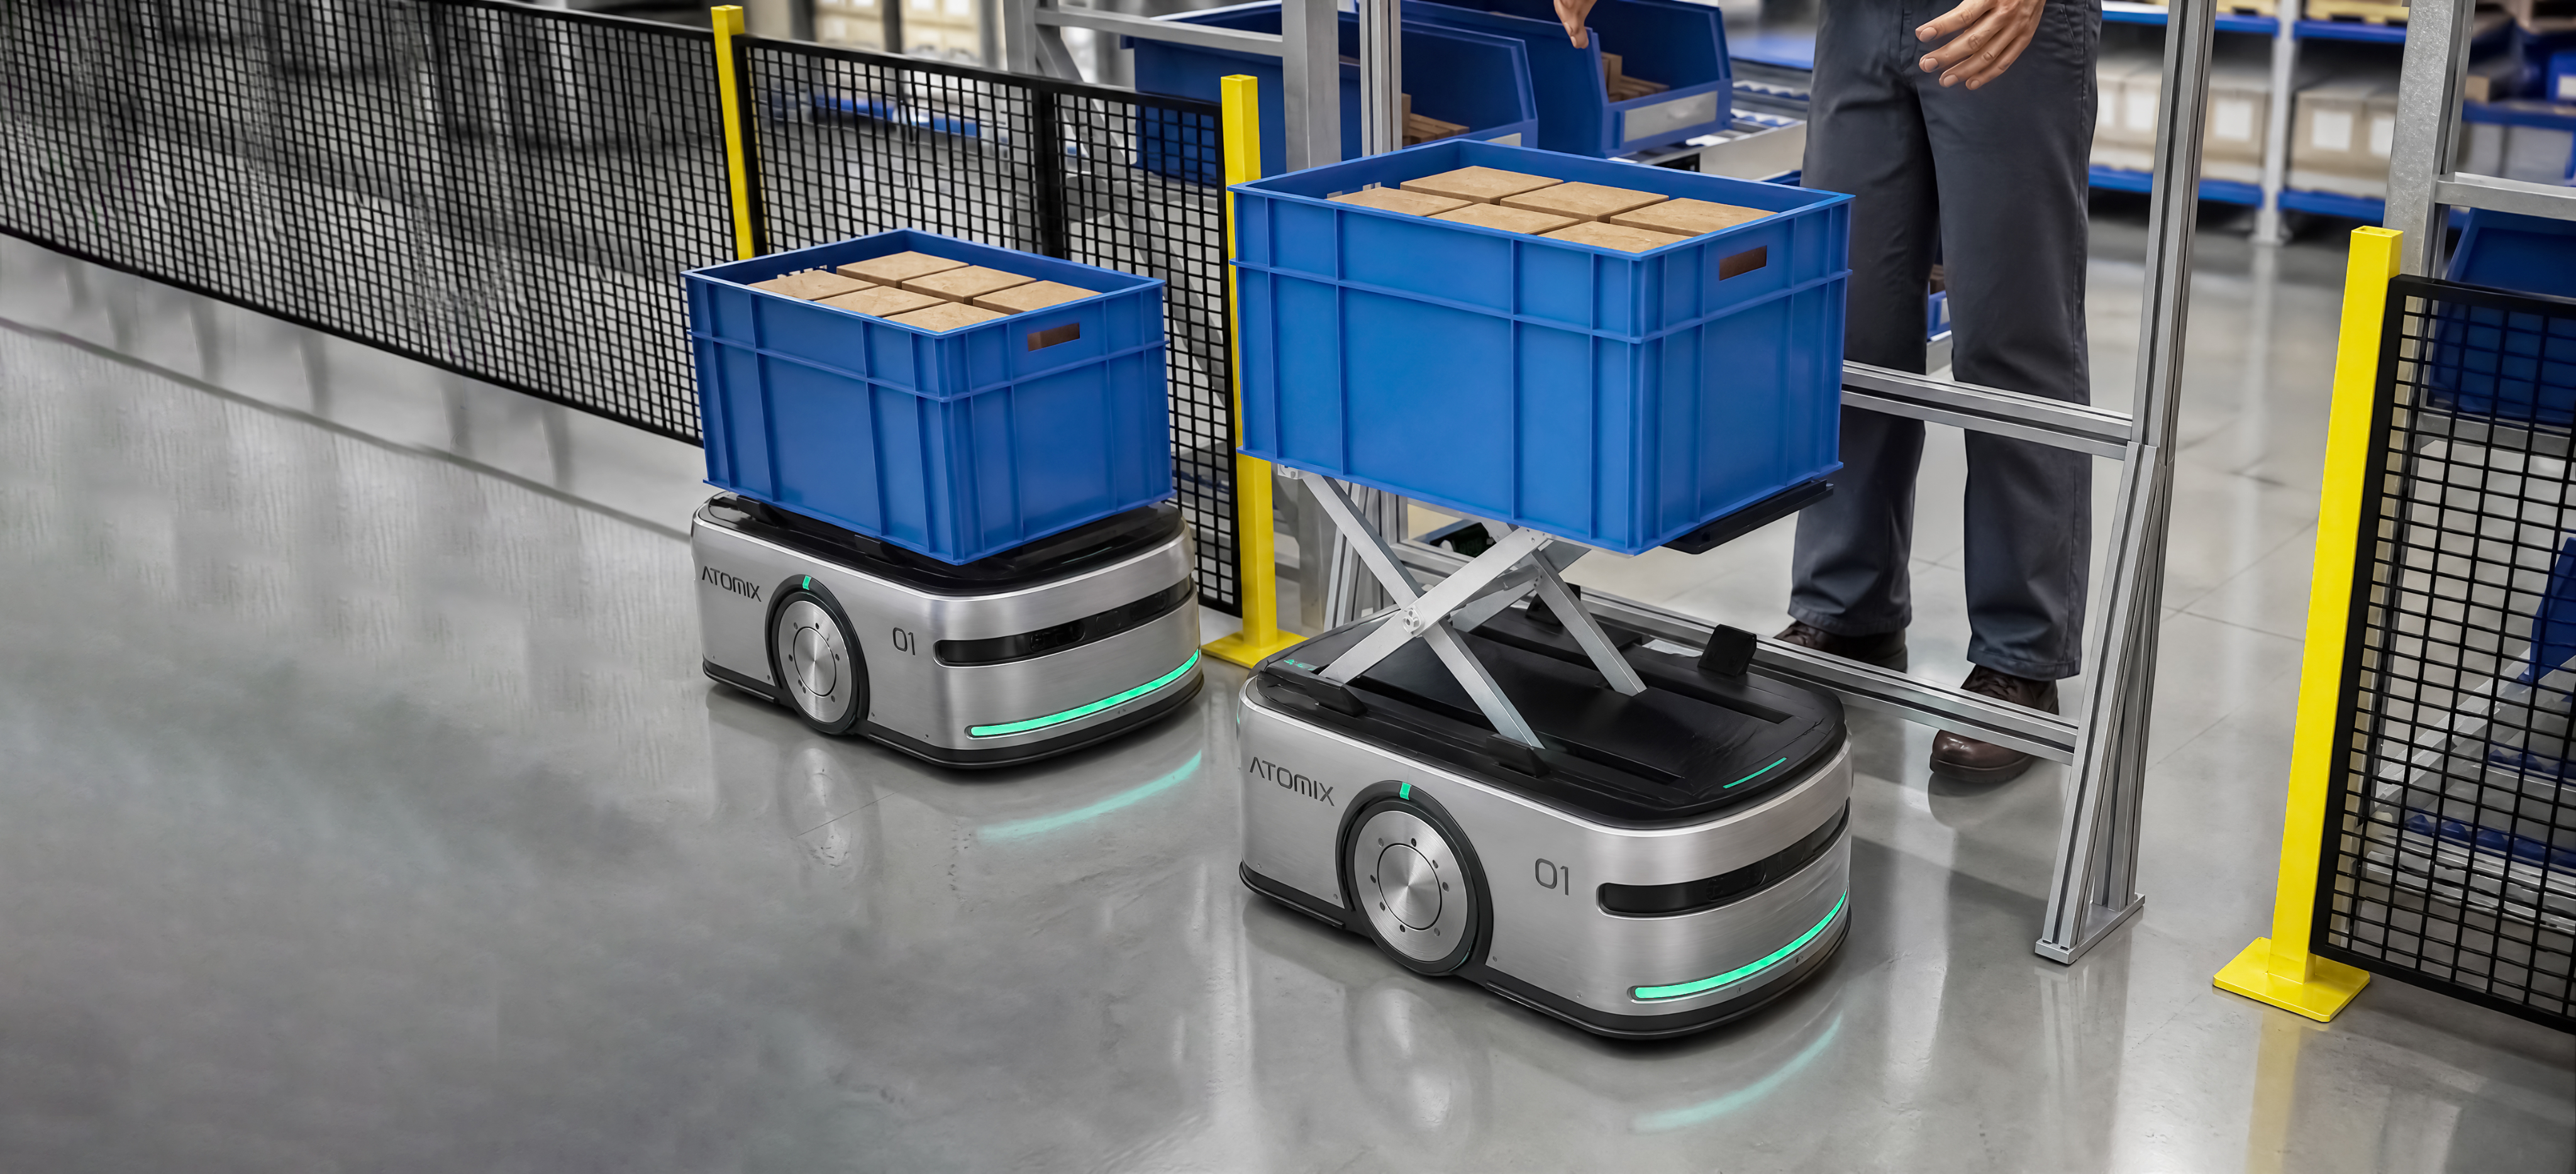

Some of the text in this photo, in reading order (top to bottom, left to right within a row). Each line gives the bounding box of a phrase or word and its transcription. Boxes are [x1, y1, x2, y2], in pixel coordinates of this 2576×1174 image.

[701, 565, 762, 602] ATOMIX
[892, 627, 916, 656] 01
[1249, 756, 1335, 807] ATOMIX
[1535, 858, 1570, 896] 01
